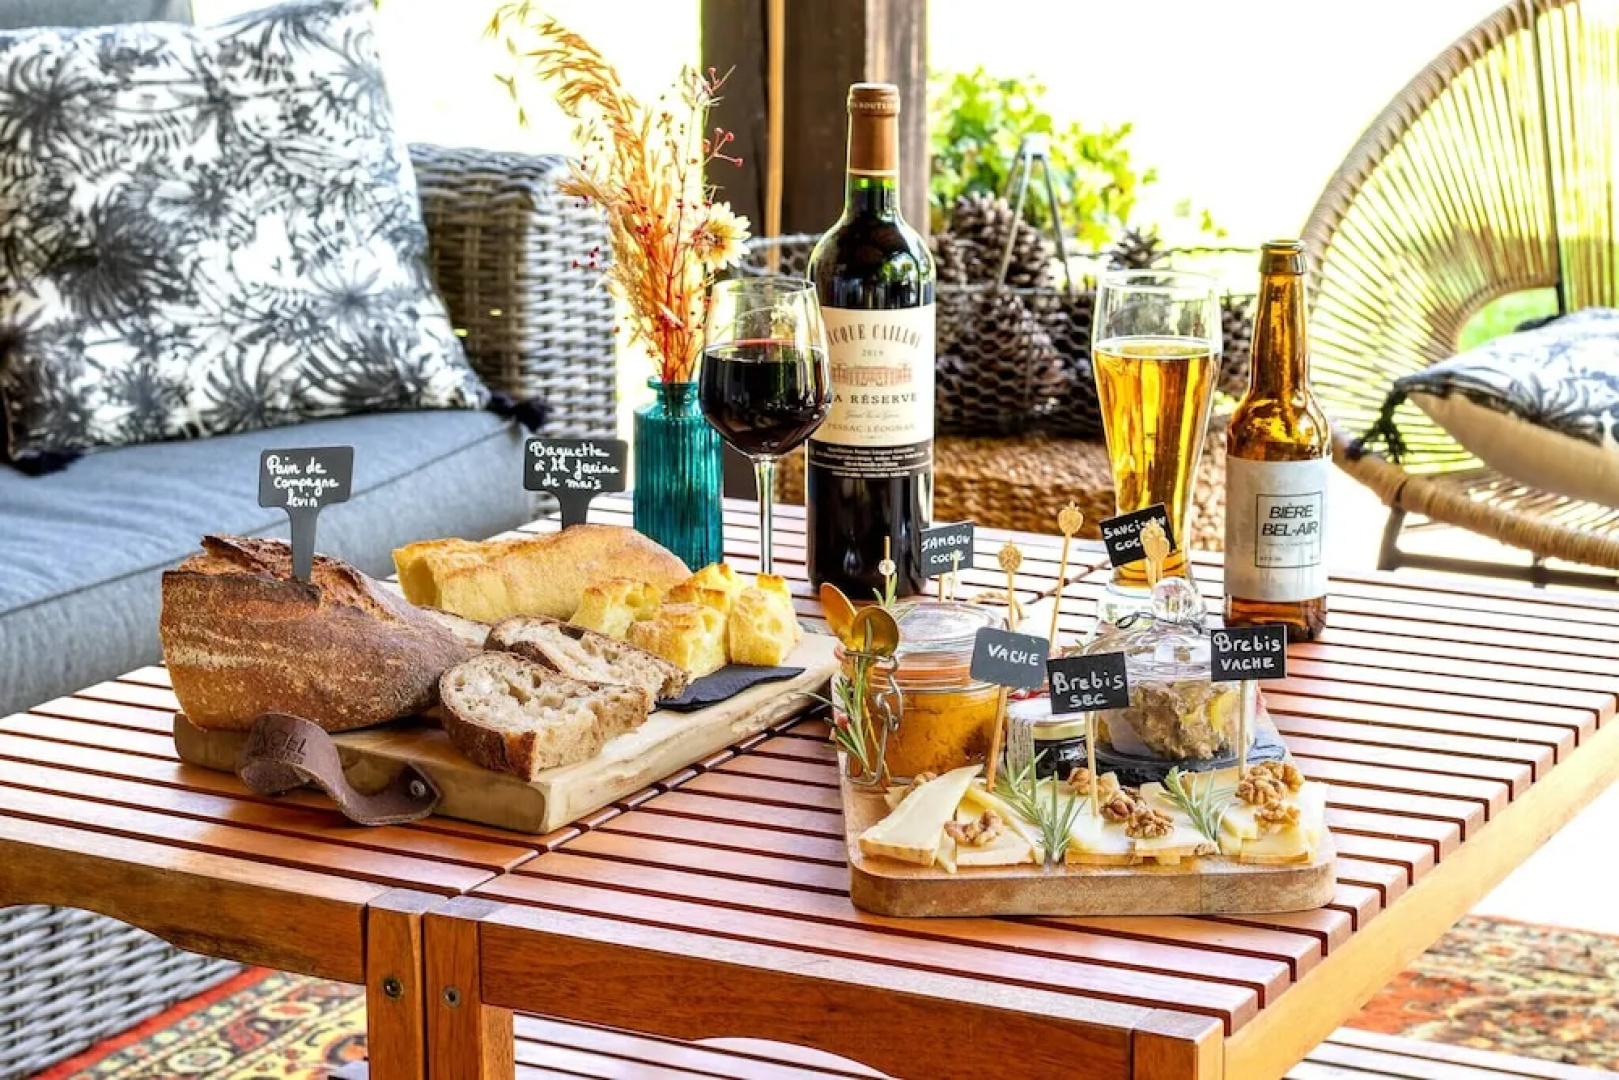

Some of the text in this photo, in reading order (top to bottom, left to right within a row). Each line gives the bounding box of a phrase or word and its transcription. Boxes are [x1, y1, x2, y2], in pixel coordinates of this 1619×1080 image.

[529, 441, 610, 458] Baguette
[266, 455, 327, 476] Pain de
[542, 473, 560, 487] de
[1269, 501, 1314, 518] BIÈRE
[1262, 521, 1318, 536] BEL-AIR
[1213, 632, 1281, 652] Brebis
[988, 643, 1039, 667] VACHE
[1220, 656, 1275, 671] VACHE
[1053, 671, 1124, 695] Brebis
